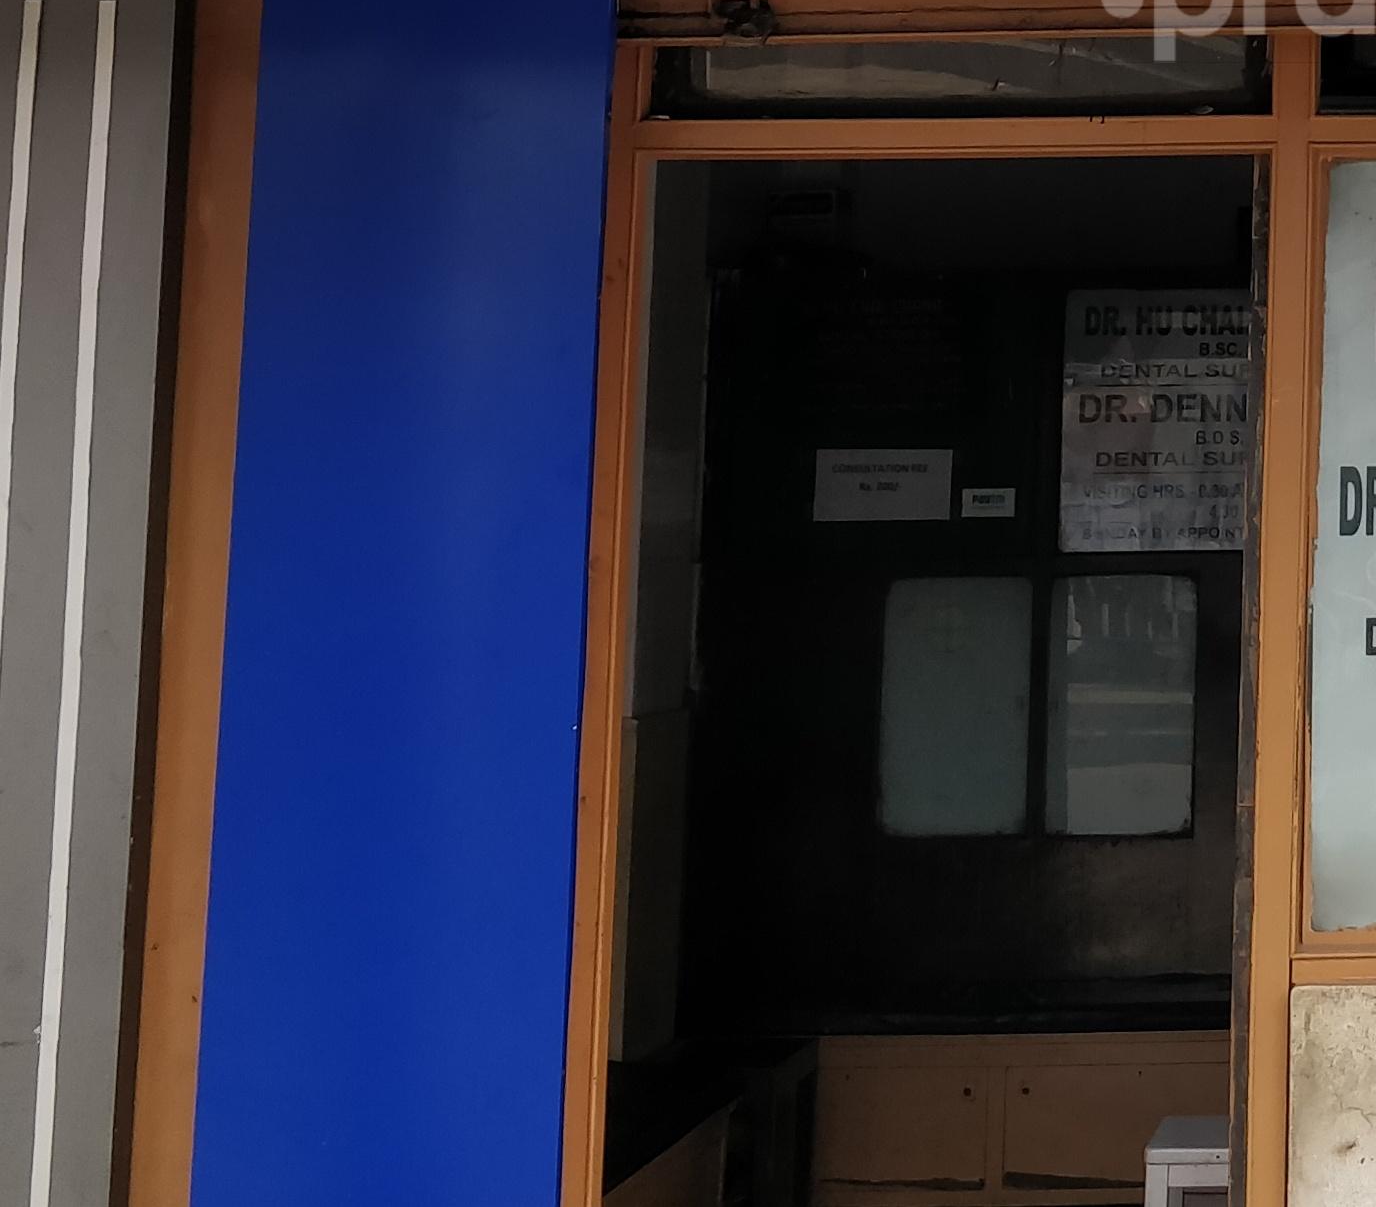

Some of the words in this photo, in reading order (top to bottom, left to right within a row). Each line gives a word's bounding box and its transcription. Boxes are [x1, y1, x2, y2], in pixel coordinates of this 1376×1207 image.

[1084, 306, 1127, 336] DR.
[1136, 305, 1173, 336] HU
[1101, 363, 1198, 378] DENTAL
[1079, 394, 1137, 423] DR.
[1096, 451, 1196, 467] DENTAL
